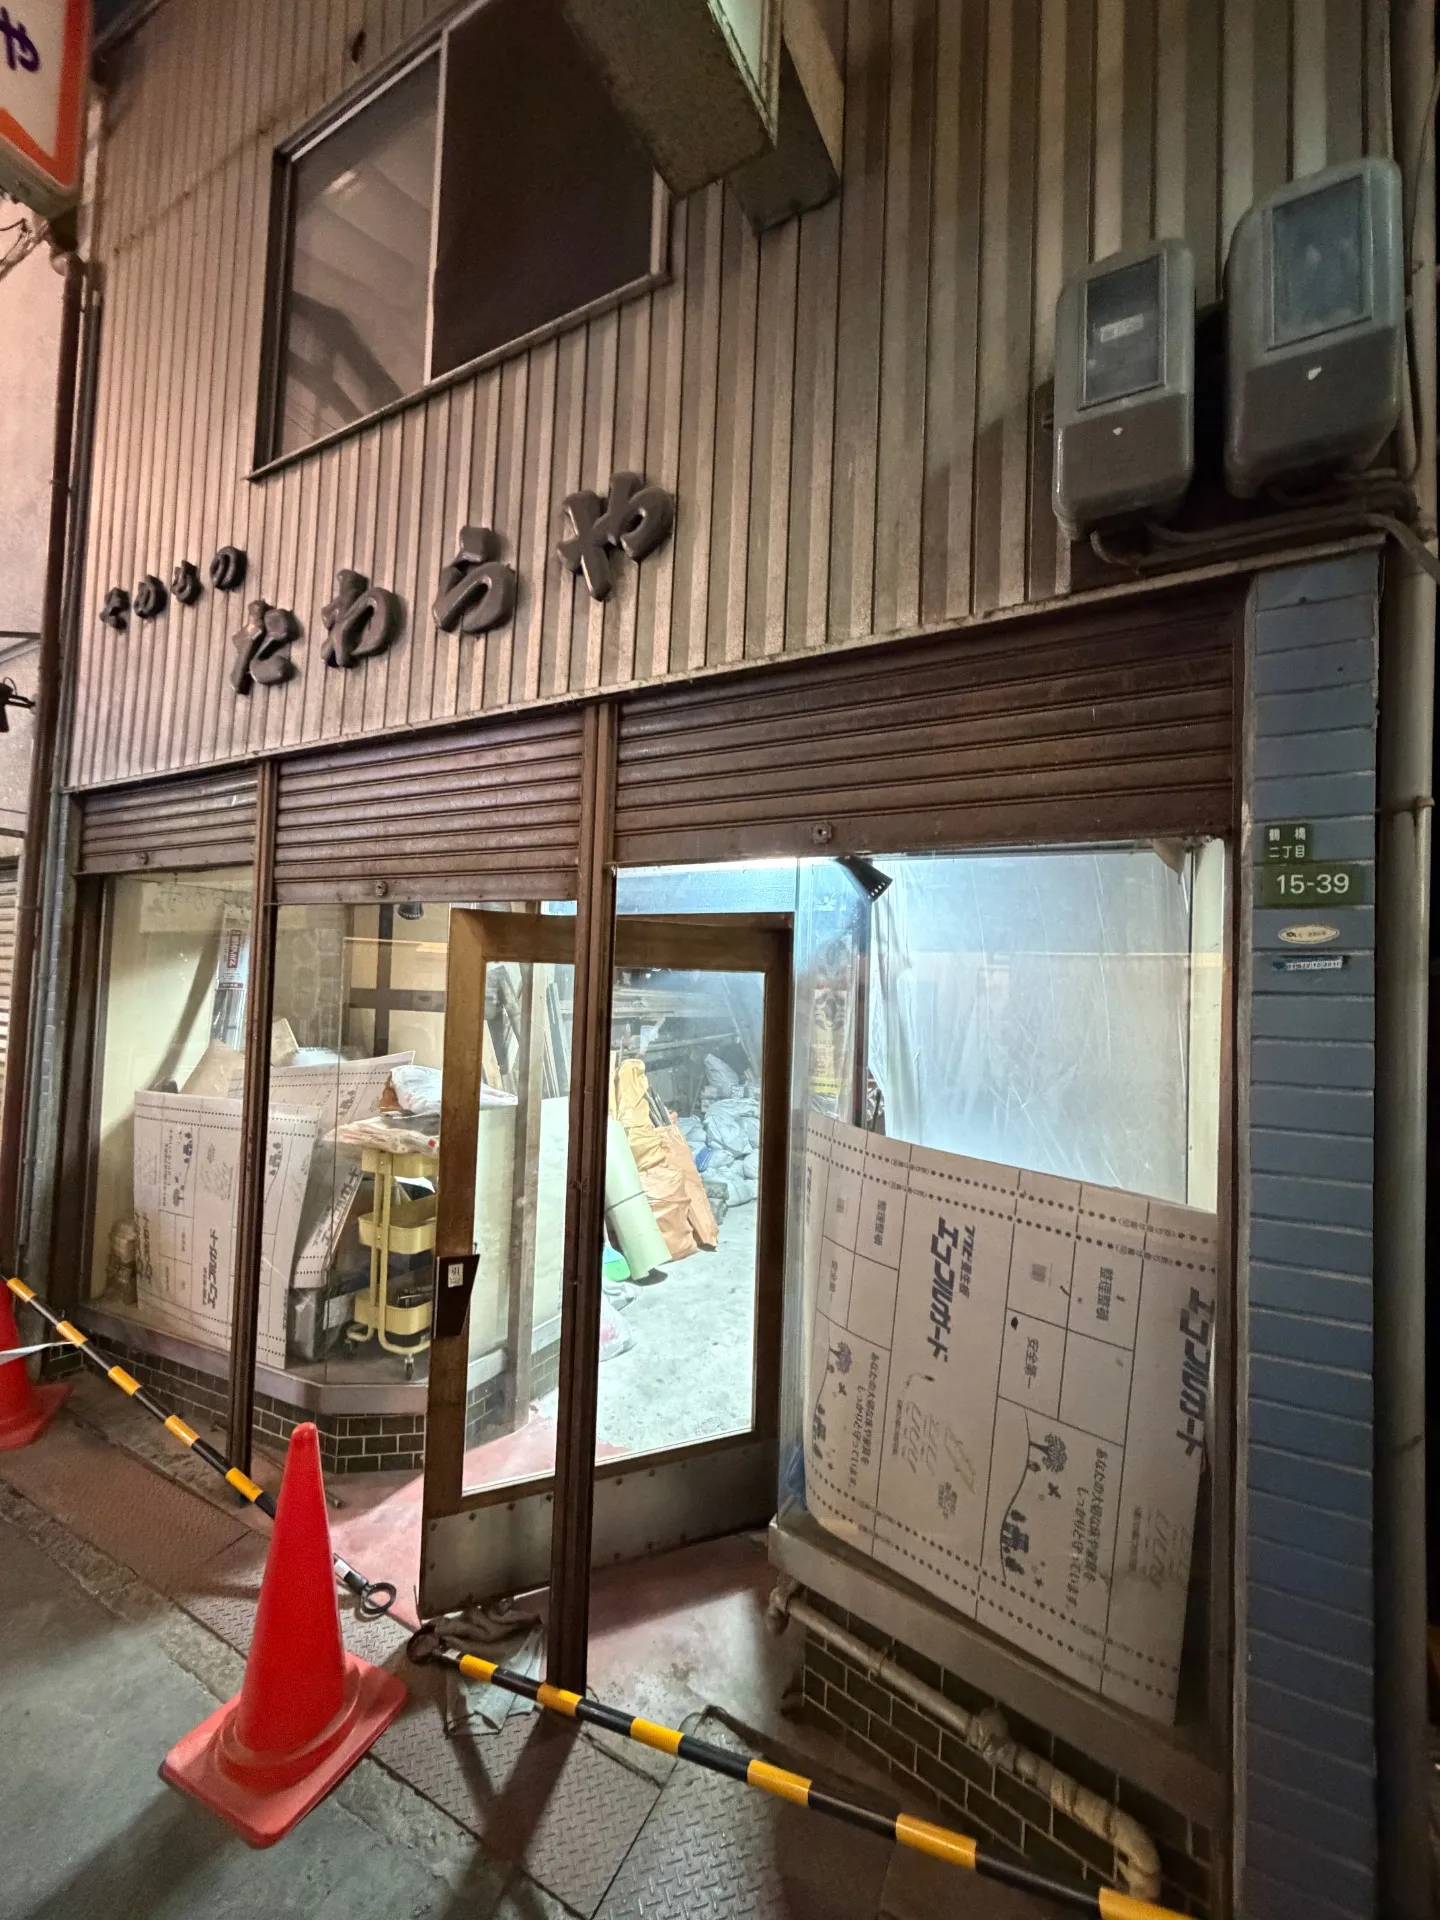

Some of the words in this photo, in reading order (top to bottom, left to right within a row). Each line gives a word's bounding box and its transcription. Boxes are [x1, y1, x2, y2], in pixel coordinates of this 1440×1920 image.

[230, 471, 676, 695] たわらや
[1268, 844, 1305, 858] 二丁目
[1276, 872, 1350, 895] 15-39
[927, 1215, 960, 1363] エコフルガード
[1095, 1265, 1114, 1321] 整理整頓
[1024, 1335, 1040, 1390] 安全第一
